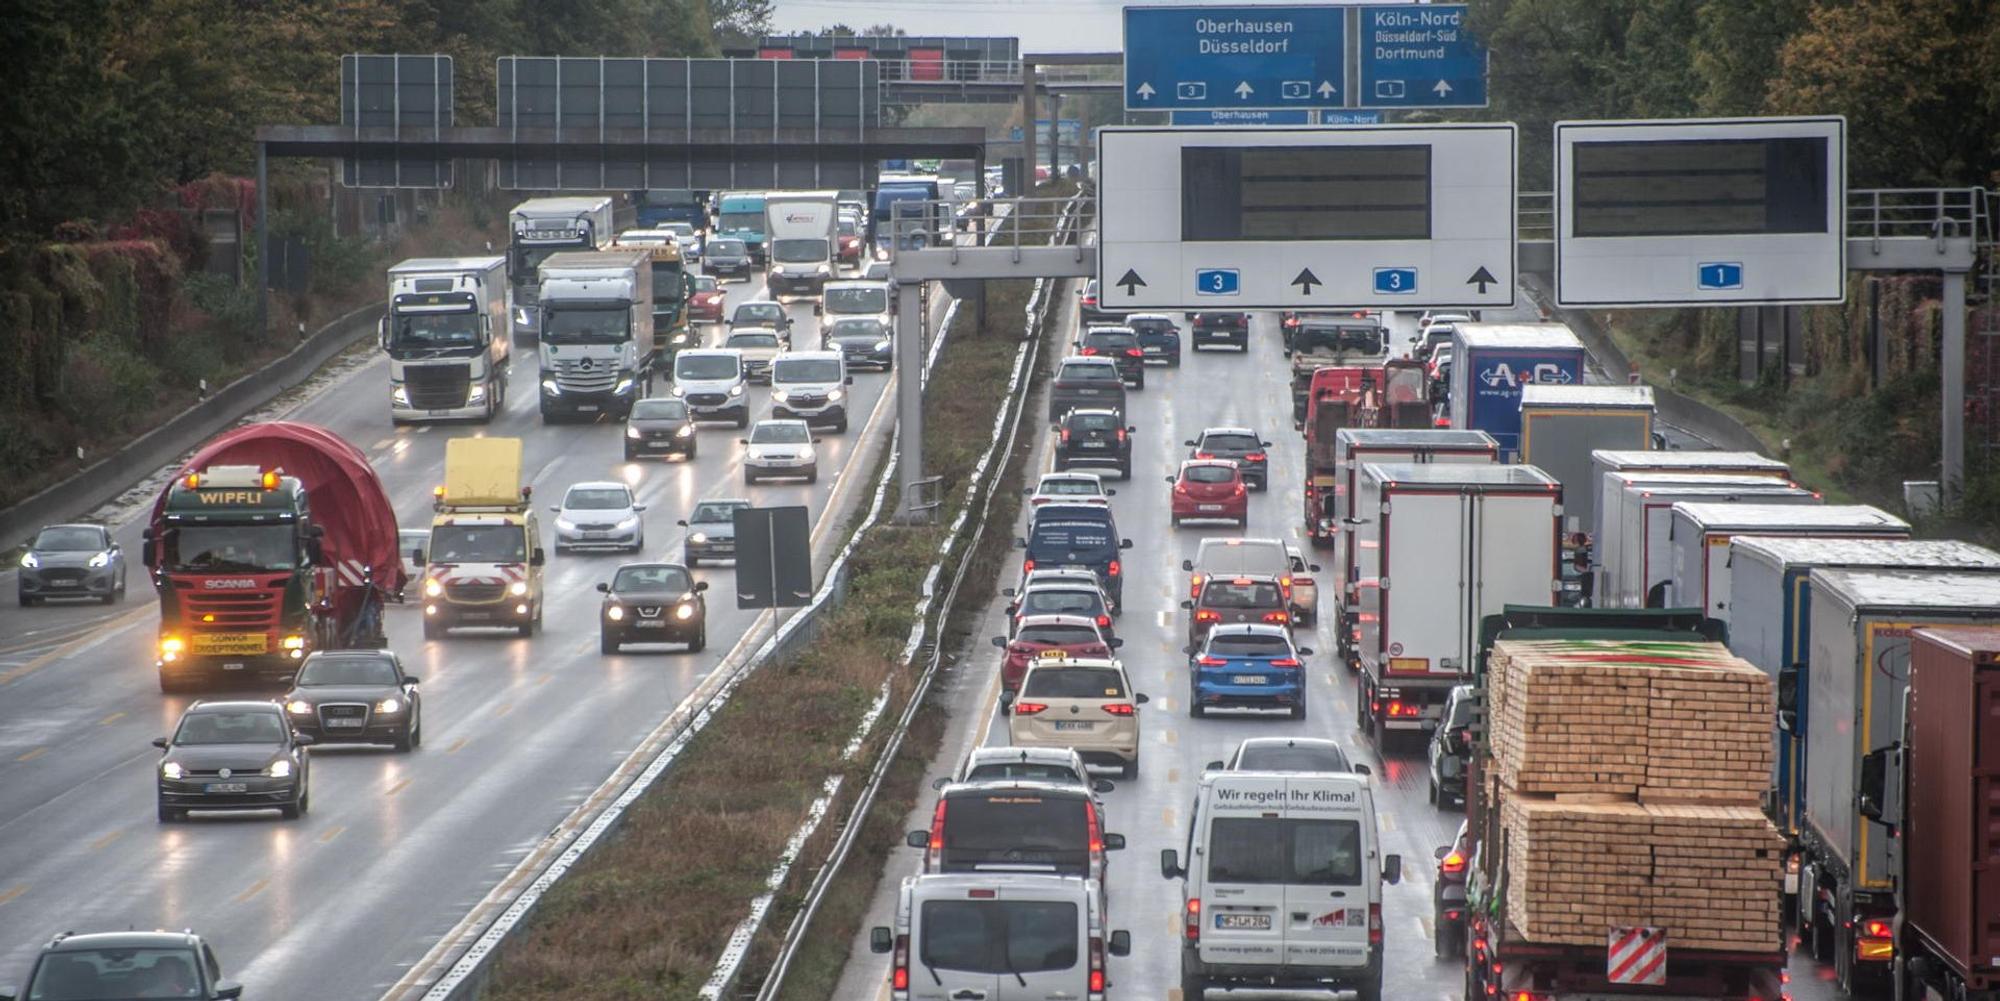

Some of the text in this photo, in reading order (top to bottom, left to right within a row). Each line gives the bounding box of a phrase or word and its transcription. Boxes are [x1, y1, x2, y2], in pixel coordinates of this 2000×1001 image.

[1375, 9, 1461, 26] Köln-Nord
[1195, 18, 1293, 34] Oberhausen
[1375, 29, 1457, 42] Düsseldorf-Süd
[1199, 38, 1289, 54] Düsseldorf
[1375, 45, 1445, 60] Dortmund
[1187, 85, 1196, 97] 3
[1292, 85, 1300, 96] 3
[1327, 114, 1378, 125] Köln-Nord
[1213, 274, 1223, 290] 3
[1390, 273, 1400, 289] 3
[1717, 267, 1725, 284] 1
[201, 491, 262, 505] WIPFLI
[204, 579, 257, 590] SCANIA
[210, 634, 248, 643] CONVOI
[195, 643, 264, 654] EXCEPTIONNEL
[1217, 788, 1356, 804] Wir regeln Ihr Klima!
